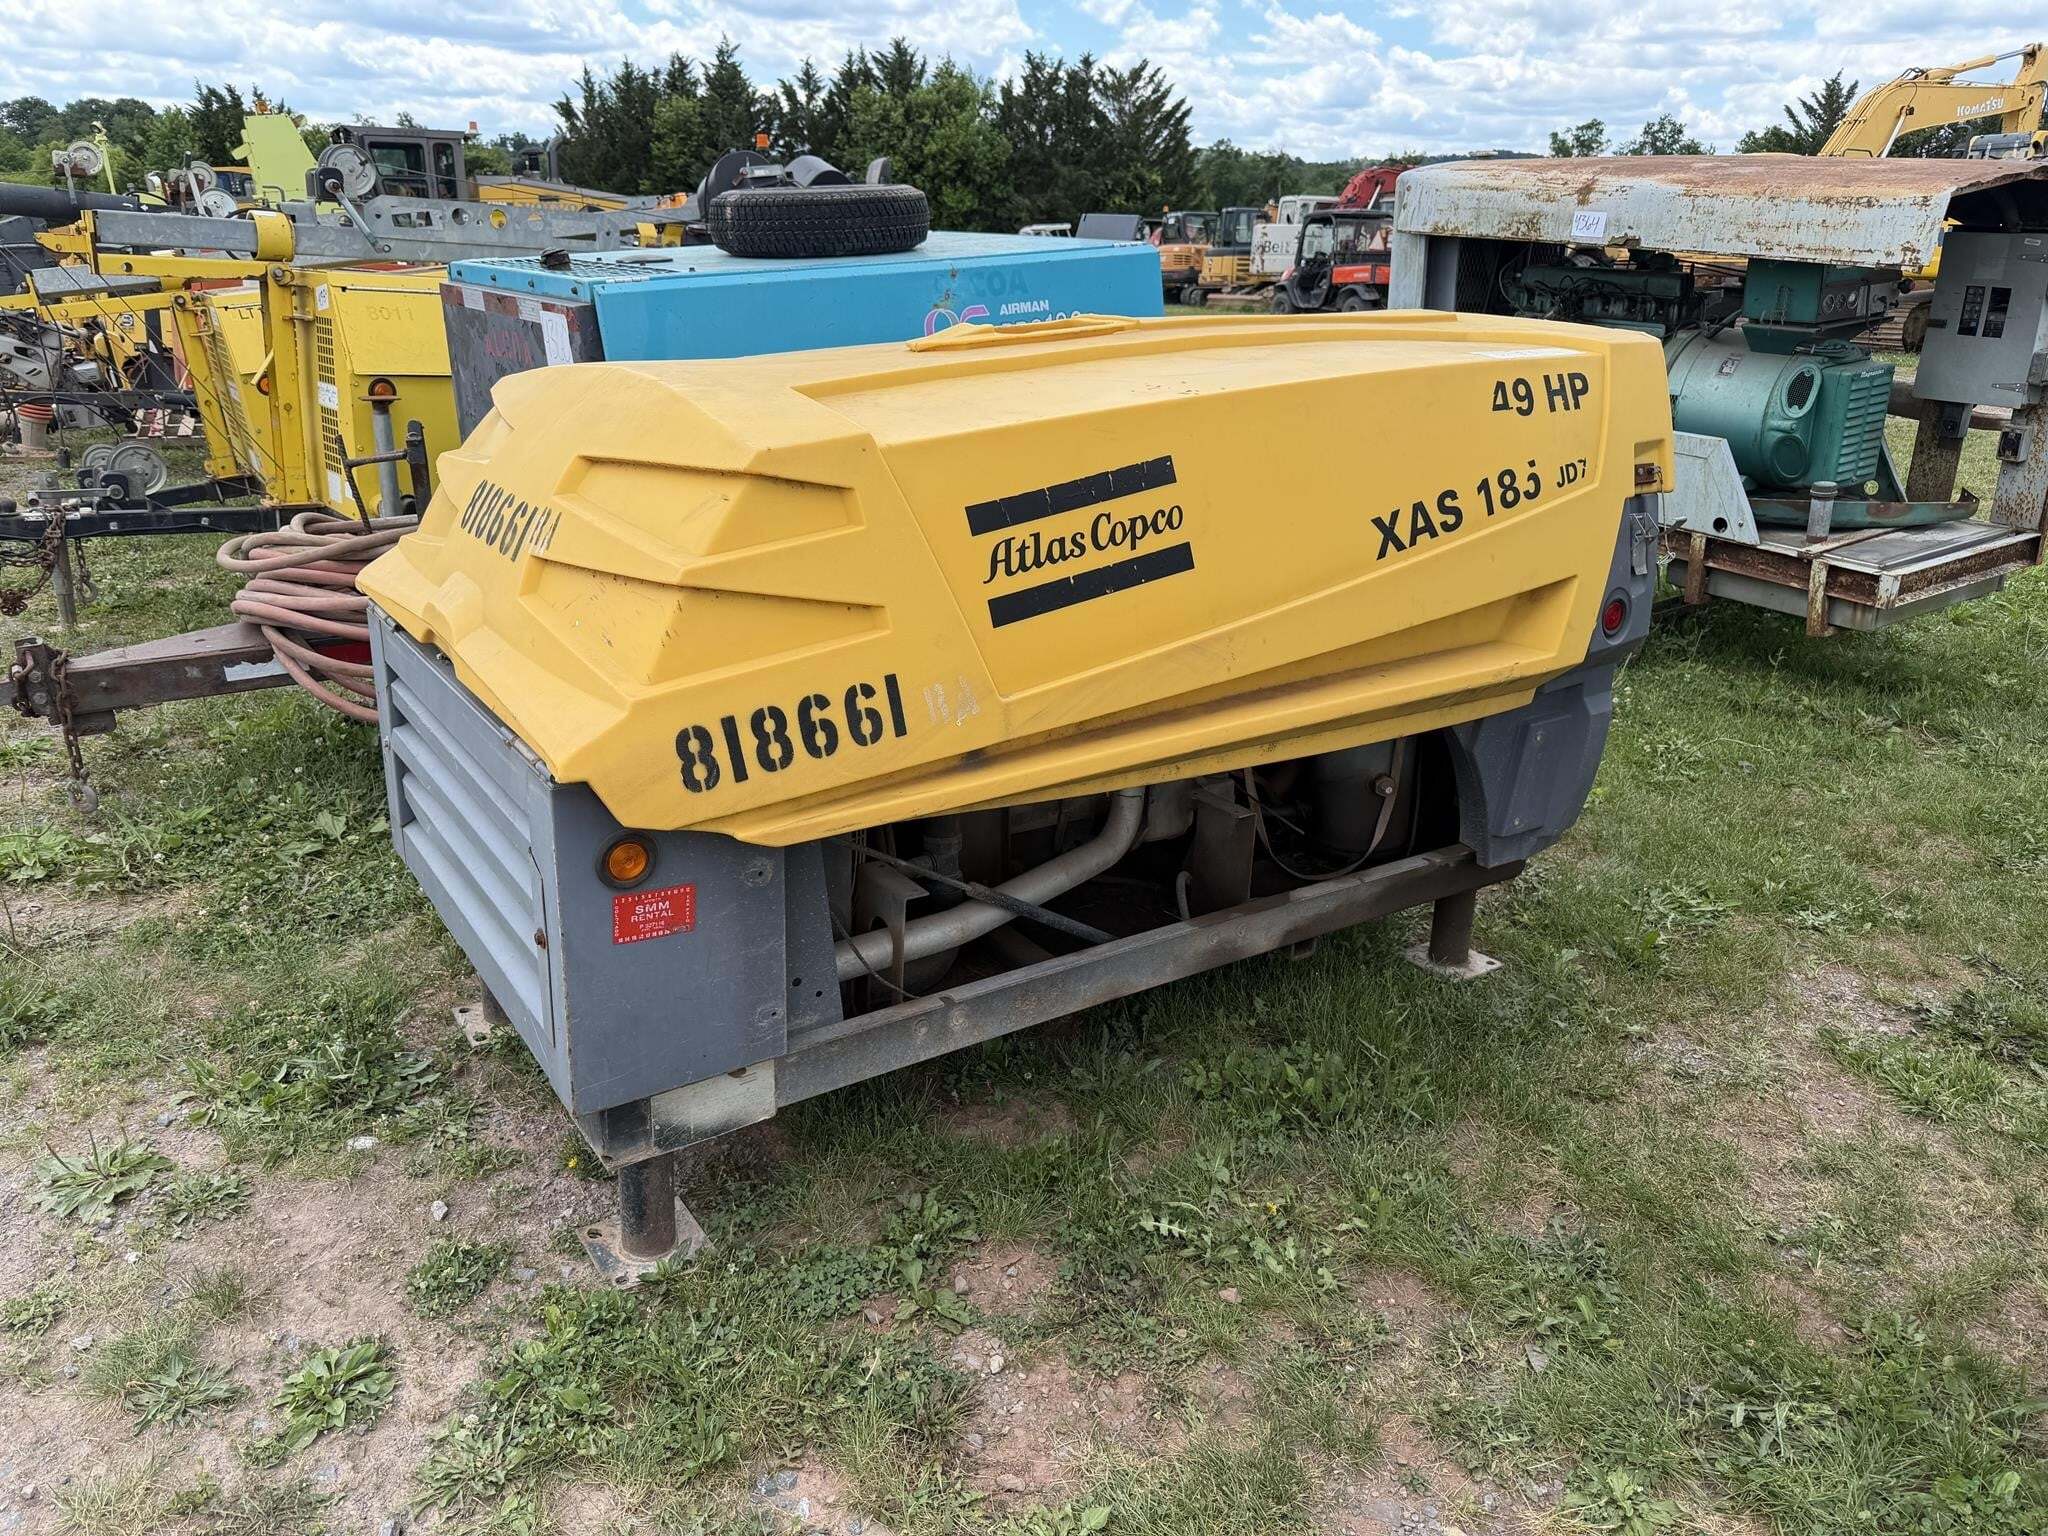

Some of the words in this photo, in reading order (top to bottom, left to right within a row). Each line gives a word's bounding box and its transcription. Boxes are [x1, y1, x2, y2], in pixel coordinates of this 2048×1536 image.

[1956, 96, 2004, 117] KOMATSU
[999, 300, 1050, 316] AIRMAN
[1491, 377, 1535, 417] 49
[1543, 372, 1589, 413] HP
[1371, 489, 1464, 561] XAS
[1556, 457, 1587, 488] JD7
[982, 531, 1087, 585] Atlas
[1090, 505, 1184, 551] Copco
[675, 673, 908, 794] 818661
[631, 909, 675, 923] RENTAL
[635, 900, 670, 914] SMM
